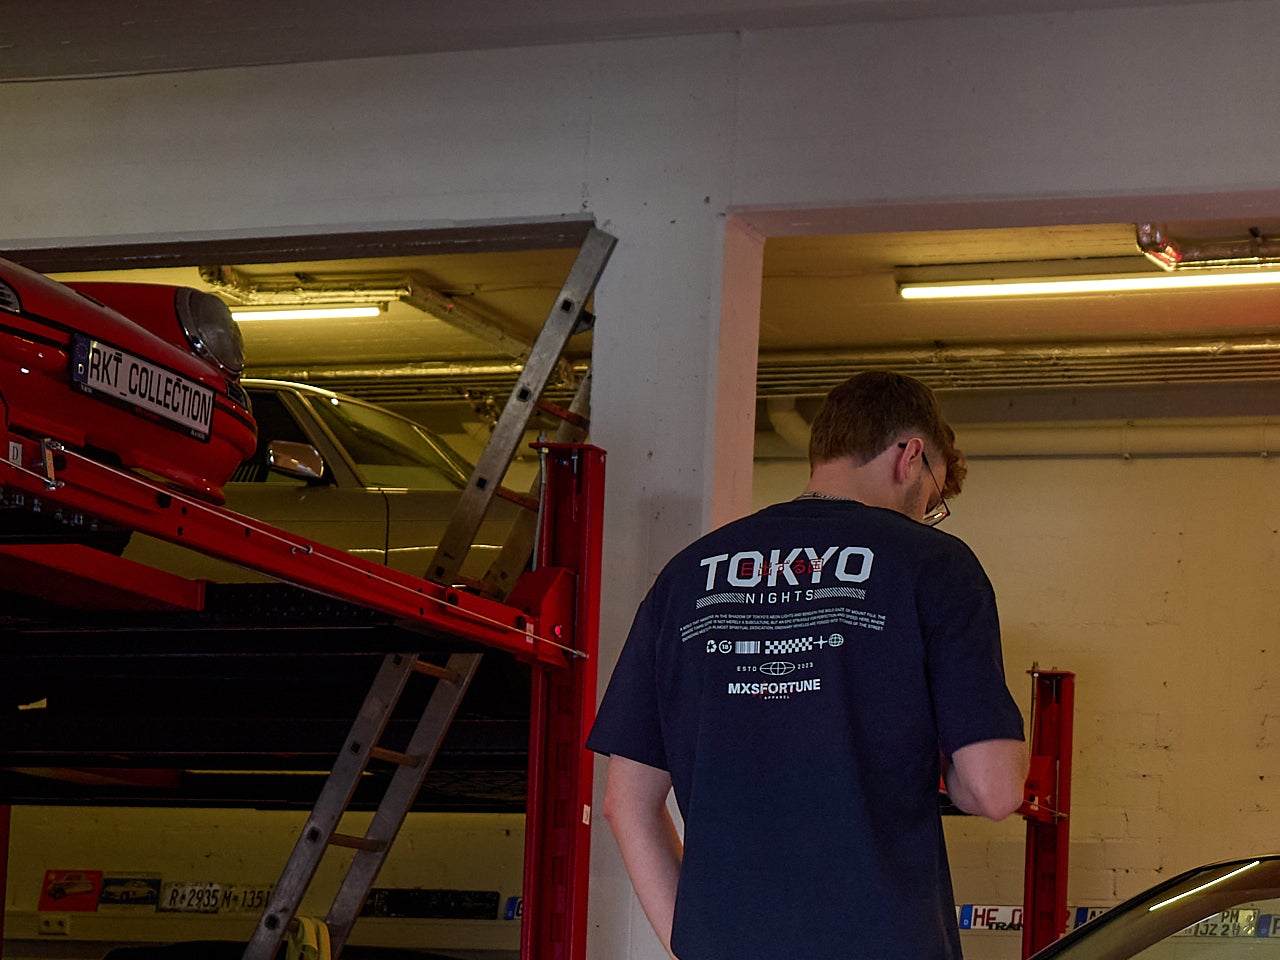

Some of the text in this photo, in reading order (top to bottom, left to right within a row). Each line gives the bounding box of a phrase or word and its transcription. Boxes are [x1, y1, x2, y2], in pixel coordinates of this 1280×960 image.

[699, 546, 874, 591] TOKYO
[745, 590, 815, 604] NIGHTS
[797, 662, 814, 670] 2023
[727, 678, 821, 695] MXSFORTUNE
[188, 889, 219, 907] 2935
